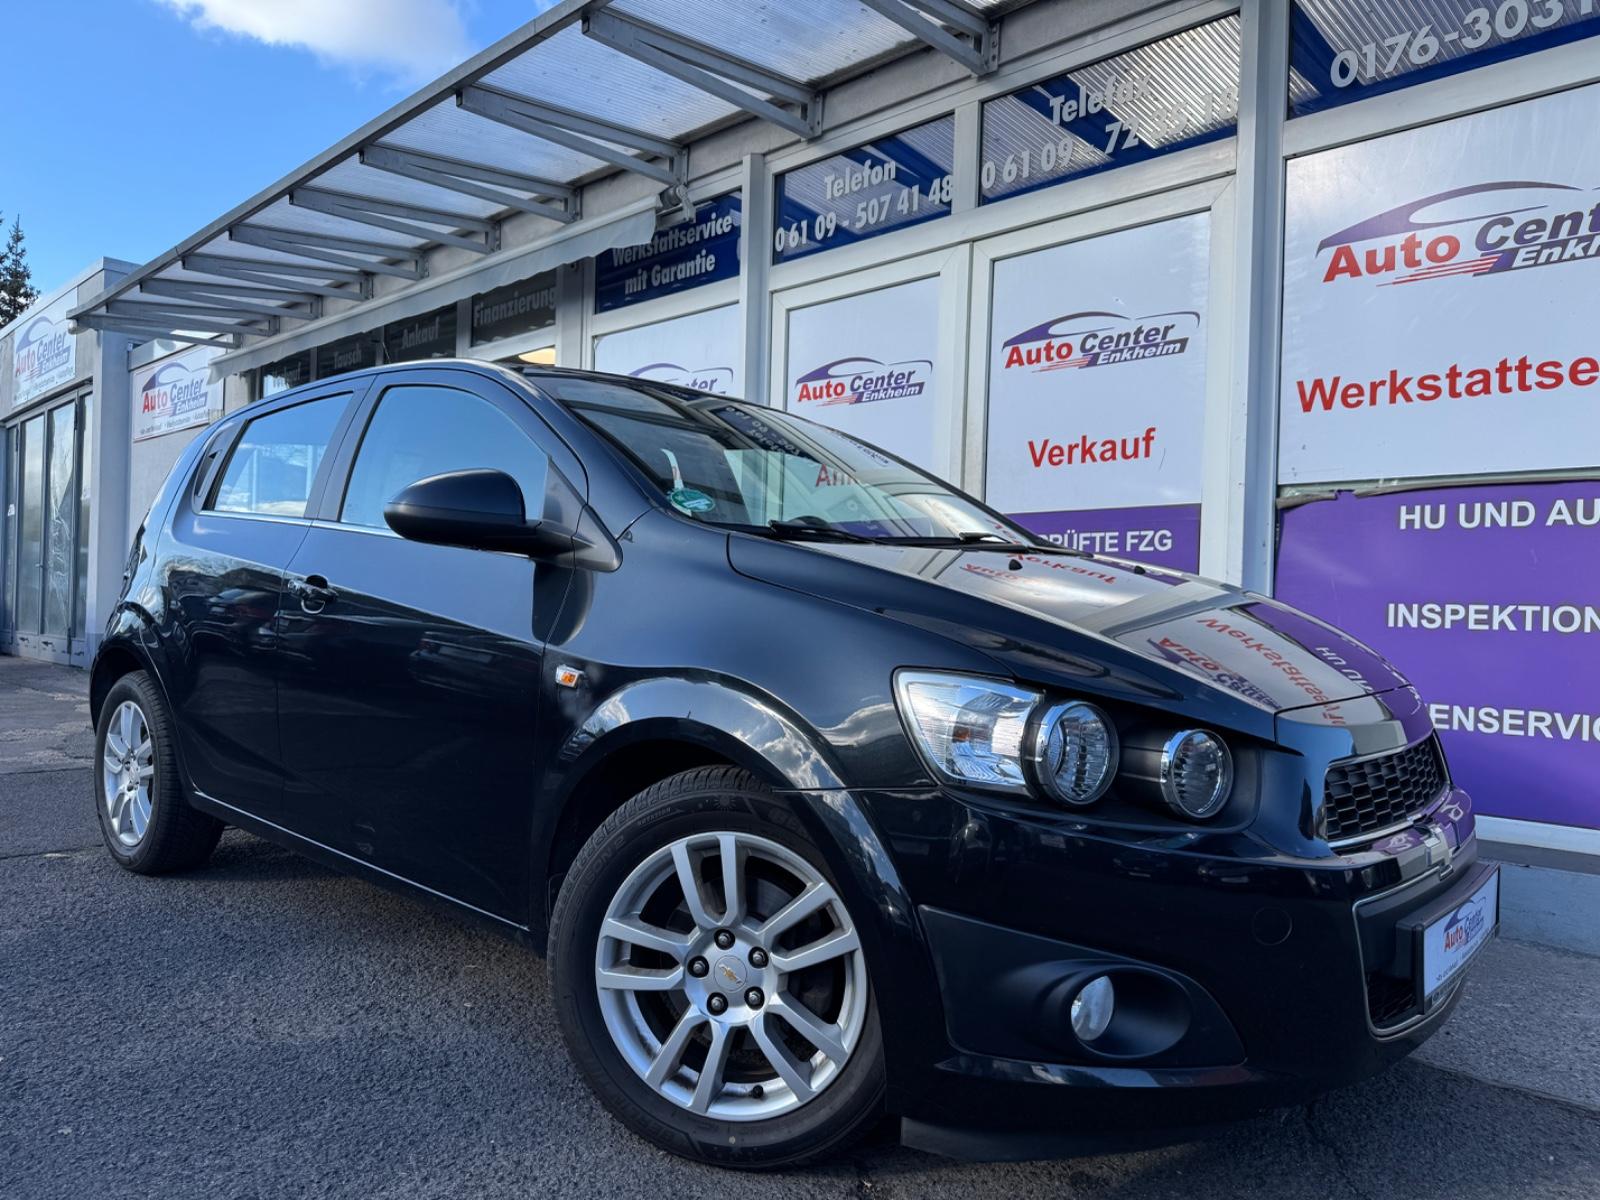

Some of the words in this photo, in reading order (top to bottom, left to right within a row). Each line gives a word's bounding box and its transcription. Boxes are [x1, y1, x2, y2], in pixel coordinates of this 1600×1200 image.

[1049, 75, 1150, 126] Telefax
[1104, 117, 1142, 155] 72
[824, 159, 896, 200] Telefon
[775, 227, 785, 252] 0
[789, 219, 808, 248] 61
[815, 212, 837, 240] 09
[855, 193, 893, 229] 507
[897, 184, 919, 215] 41
[928, 175, 953, 205] 48
[612, 212, 732, 267] Werkstattservice
[1322, 232, 1461, 283] Auto
[624, 267, 649, 295] mit
[651, 248, 716, 287] Garantie
[474, 288, 556, 327] Finanzierung
[402, 316, 440, 350] Ankauf
[1005, 340, 1073, 369] Auto
[1079, 323, 1176, 354] Center
[15, 348, 36, 378] Auto
[37, 331, 67, 362] Center
[1096, 342, 1181, 365] Enkheim
[142, 389, 168, 415] Auto
[170, 377, 204, 402] Center
[798, 379, 846, 402] Auto
[849, 370, 916, 392] Center
[862, 384, 920, 402] Enkheim
[1296, 355, 1600, 413] Werkstattse
[1028, 427, 1156, 468] Verkauf
[1400, 504, 1446, 530] HU
[1459, 501, 1536, 528] UND
[1545, 498, 1600, 526] AU
[1125, 529, 1173, 552] FZG
[1387, 603, 1600, 633] INSPEKTION
[1425, 703, 1600, 742] ENSERVI
[1444, 925, 1463, 952] Auto
